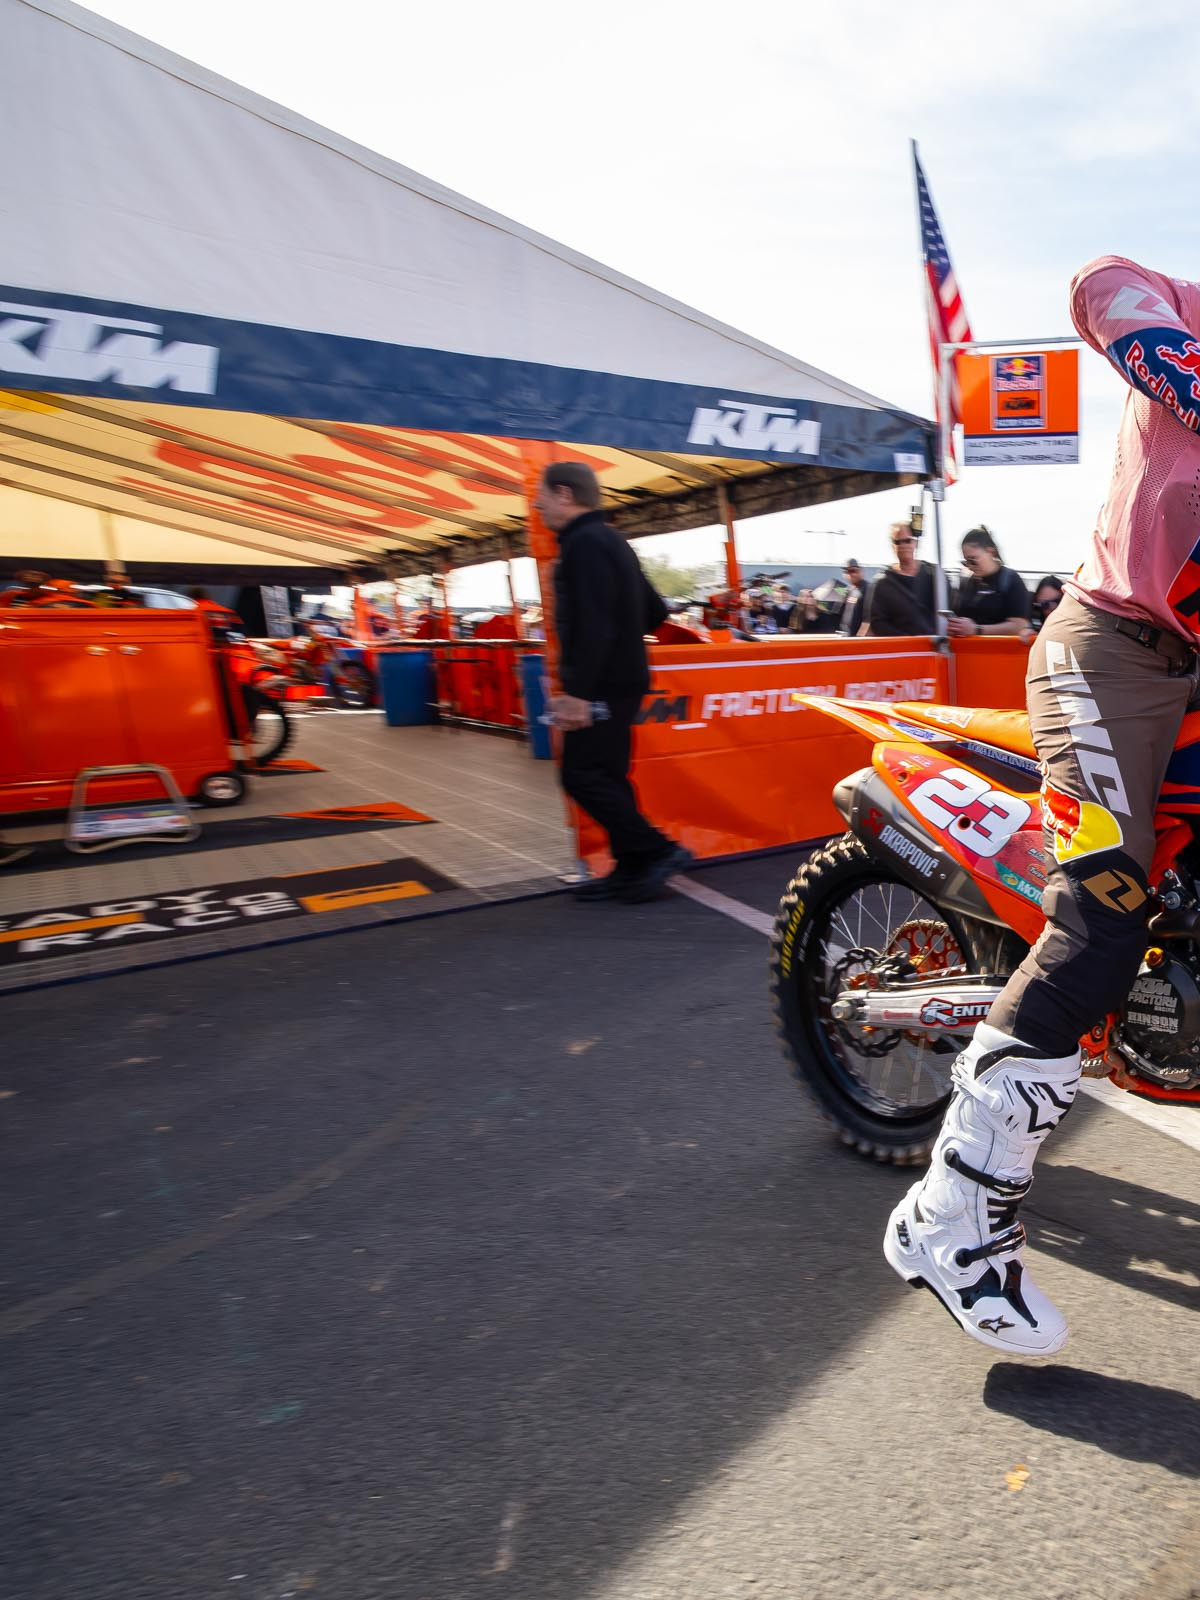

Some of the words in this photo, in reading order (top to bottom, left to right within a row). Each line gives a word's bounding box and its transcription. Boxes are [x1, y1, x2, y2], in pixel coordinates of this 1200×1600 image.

[1126, 339, 1167, 400] Red
[1160, 386, 1200, 431] Bull
[687, 400, 821, 455] KTM
[908, 767, 1032, 859] 23
[1017, 880, 1044, 905] MOTO
[1127, 991, 1178, 1009] FACTORY
[1131, 977, 1172, 996] KTM
